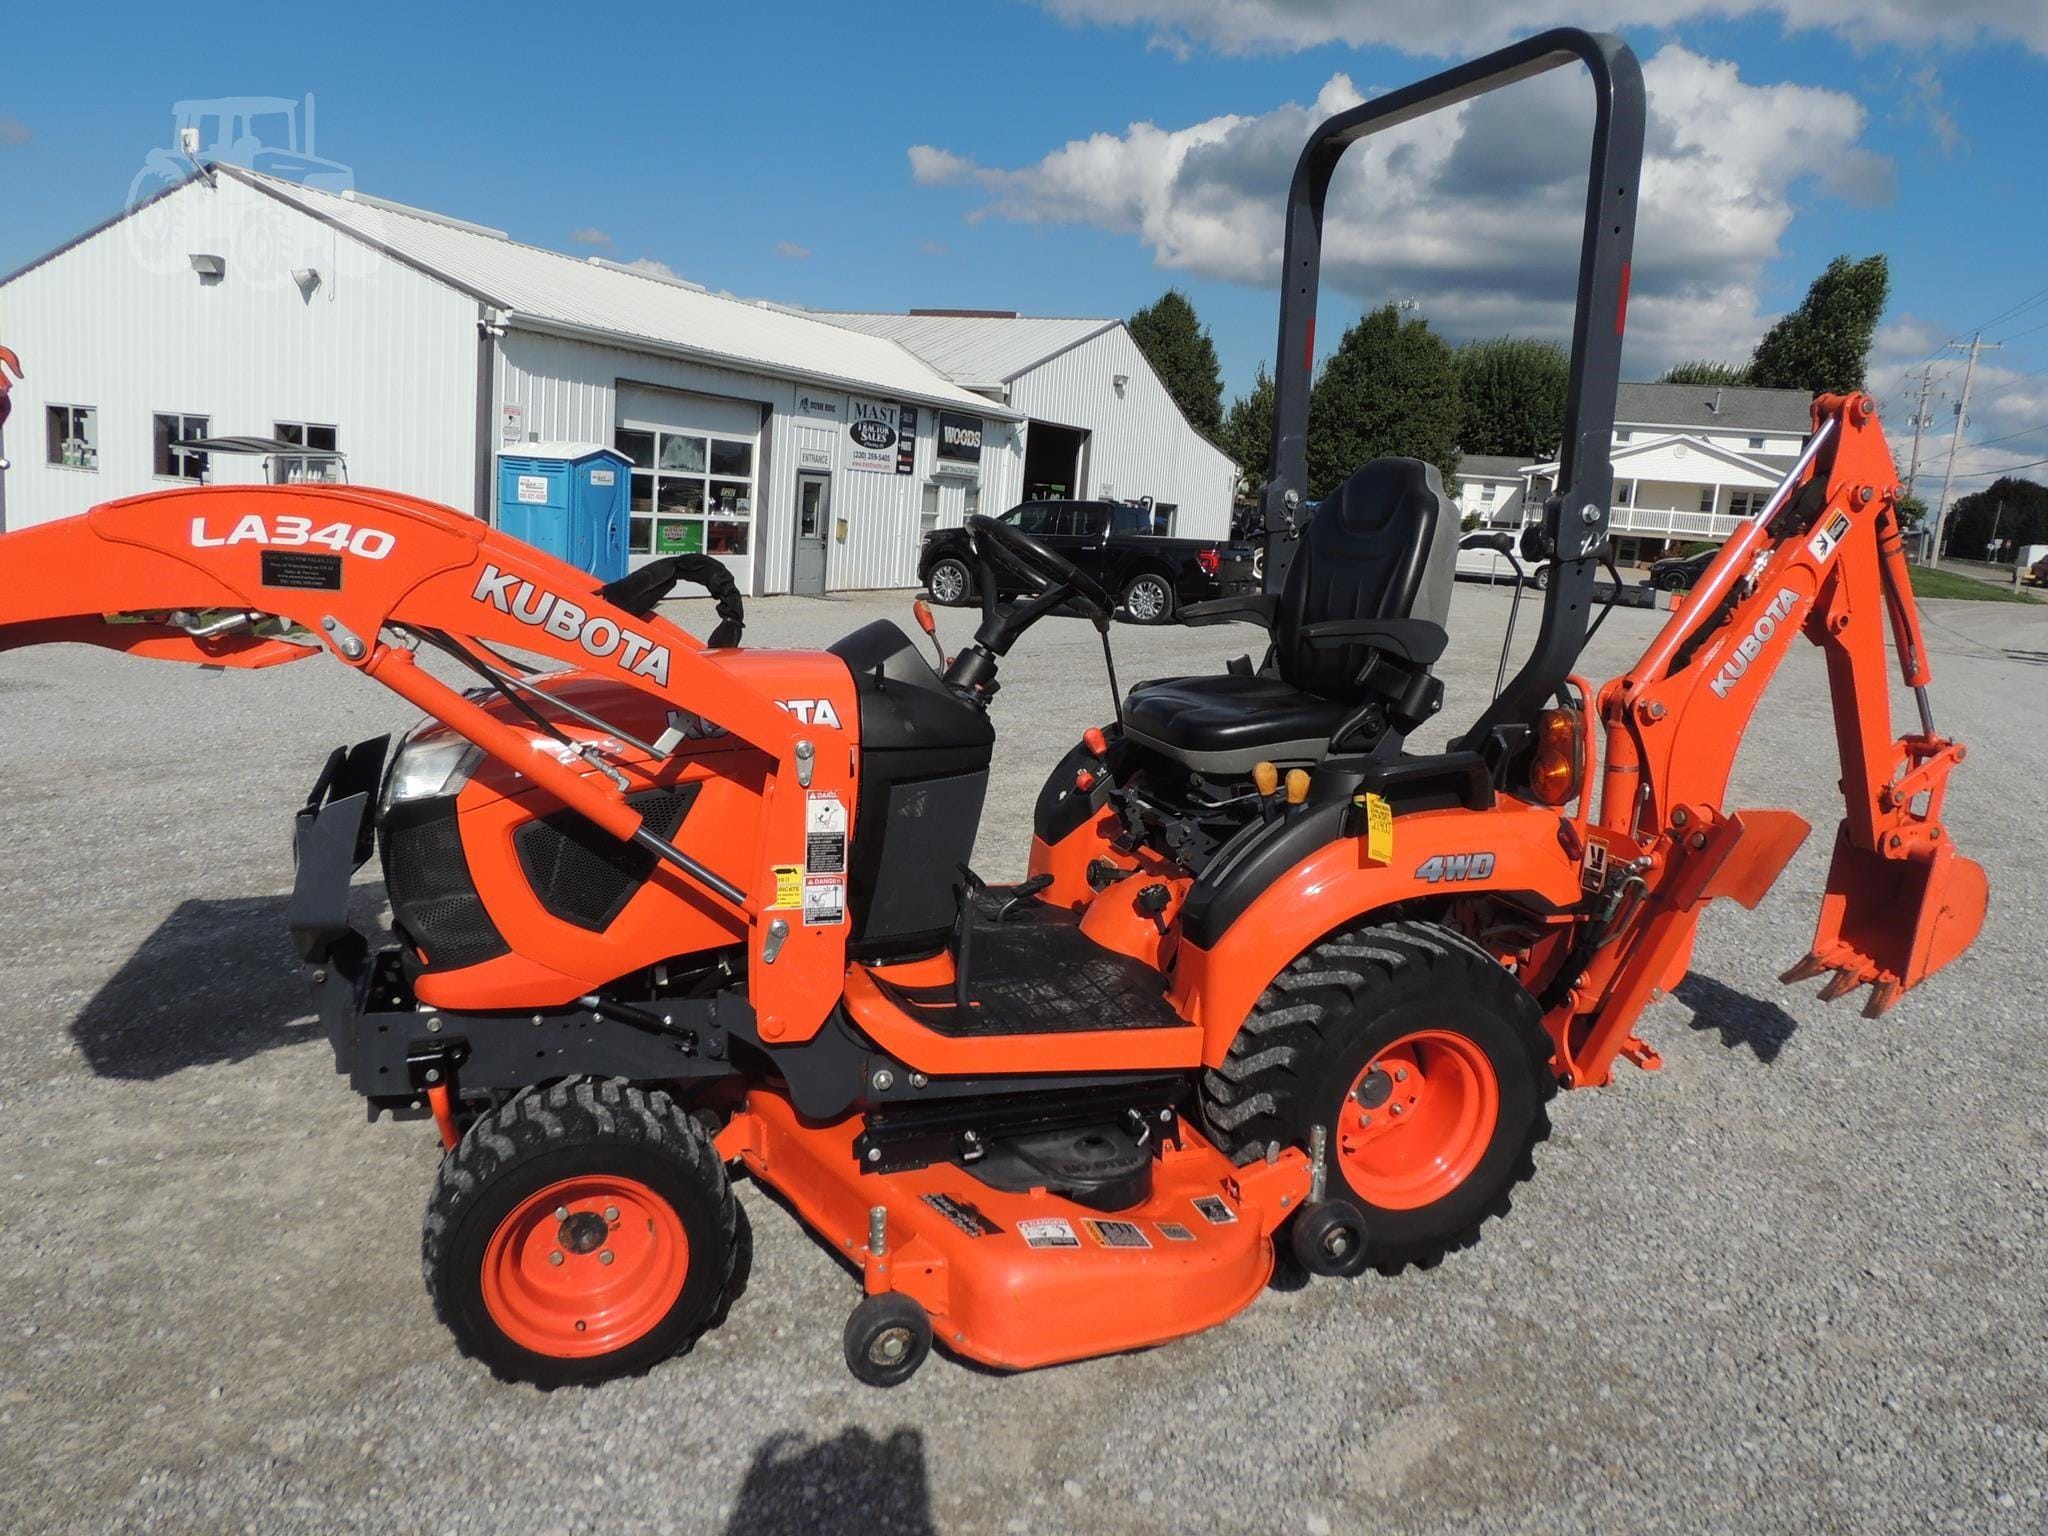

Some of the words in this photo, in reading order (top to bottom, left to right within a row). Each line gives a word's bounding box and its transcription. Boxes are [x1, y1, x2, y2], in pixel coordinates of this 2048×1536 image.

[855, 402, 896, 425] MAST
[858, 420, 889, 435] TRACTOR
[861, 431, 887, 443] SALES
[944, 426, 981, 448] WOODS
[802, 453, 829, 464] ENTRANCE
[191, 515, 396, 560] LA340
[472, 563, 671, 688] KUBOTA
[1710, 587, 1801, 699] KUBOTA
[1414, 851, 1496, 883] 4WD
